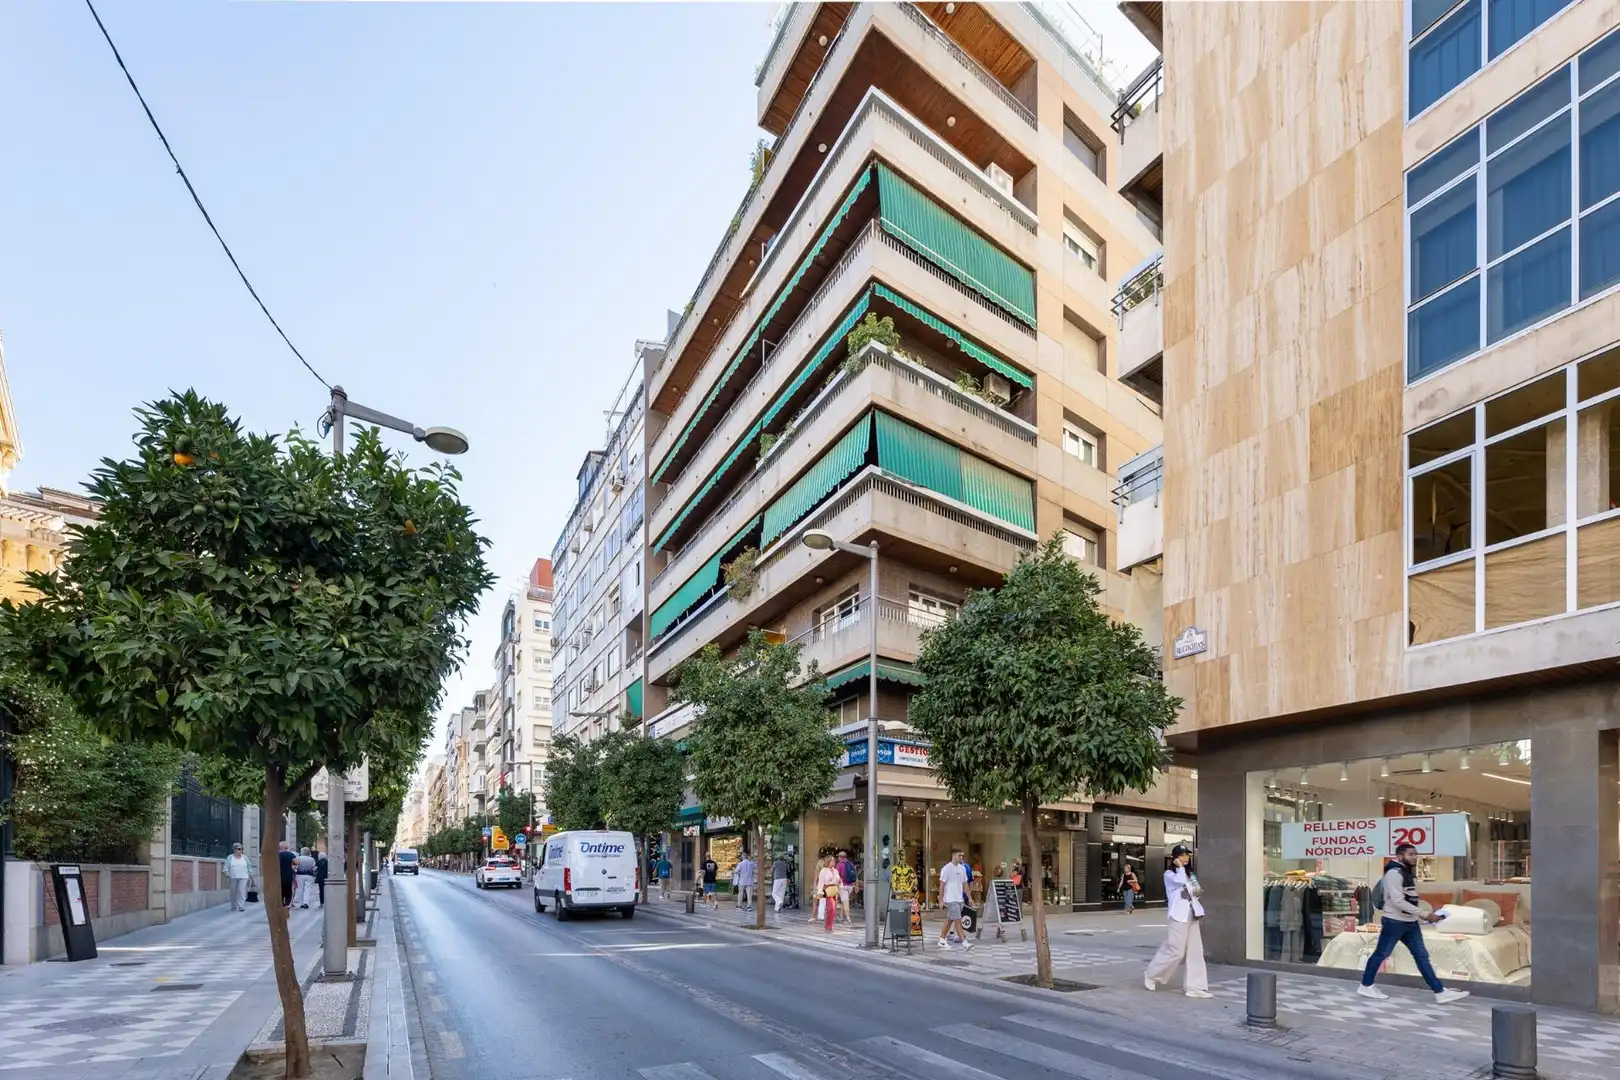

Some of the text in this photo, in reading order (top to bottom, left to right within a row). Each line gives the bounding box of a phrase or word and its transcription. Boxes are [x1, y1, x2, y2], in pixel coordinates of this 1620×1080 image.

[1303, 820, 1377, 833] RELLENOS
[1312, 835, 1367, 846] FUNDAS
[580, 842, 625, 853] Ontime
[1305, 845, 1375, 857] NÓRDICAS
